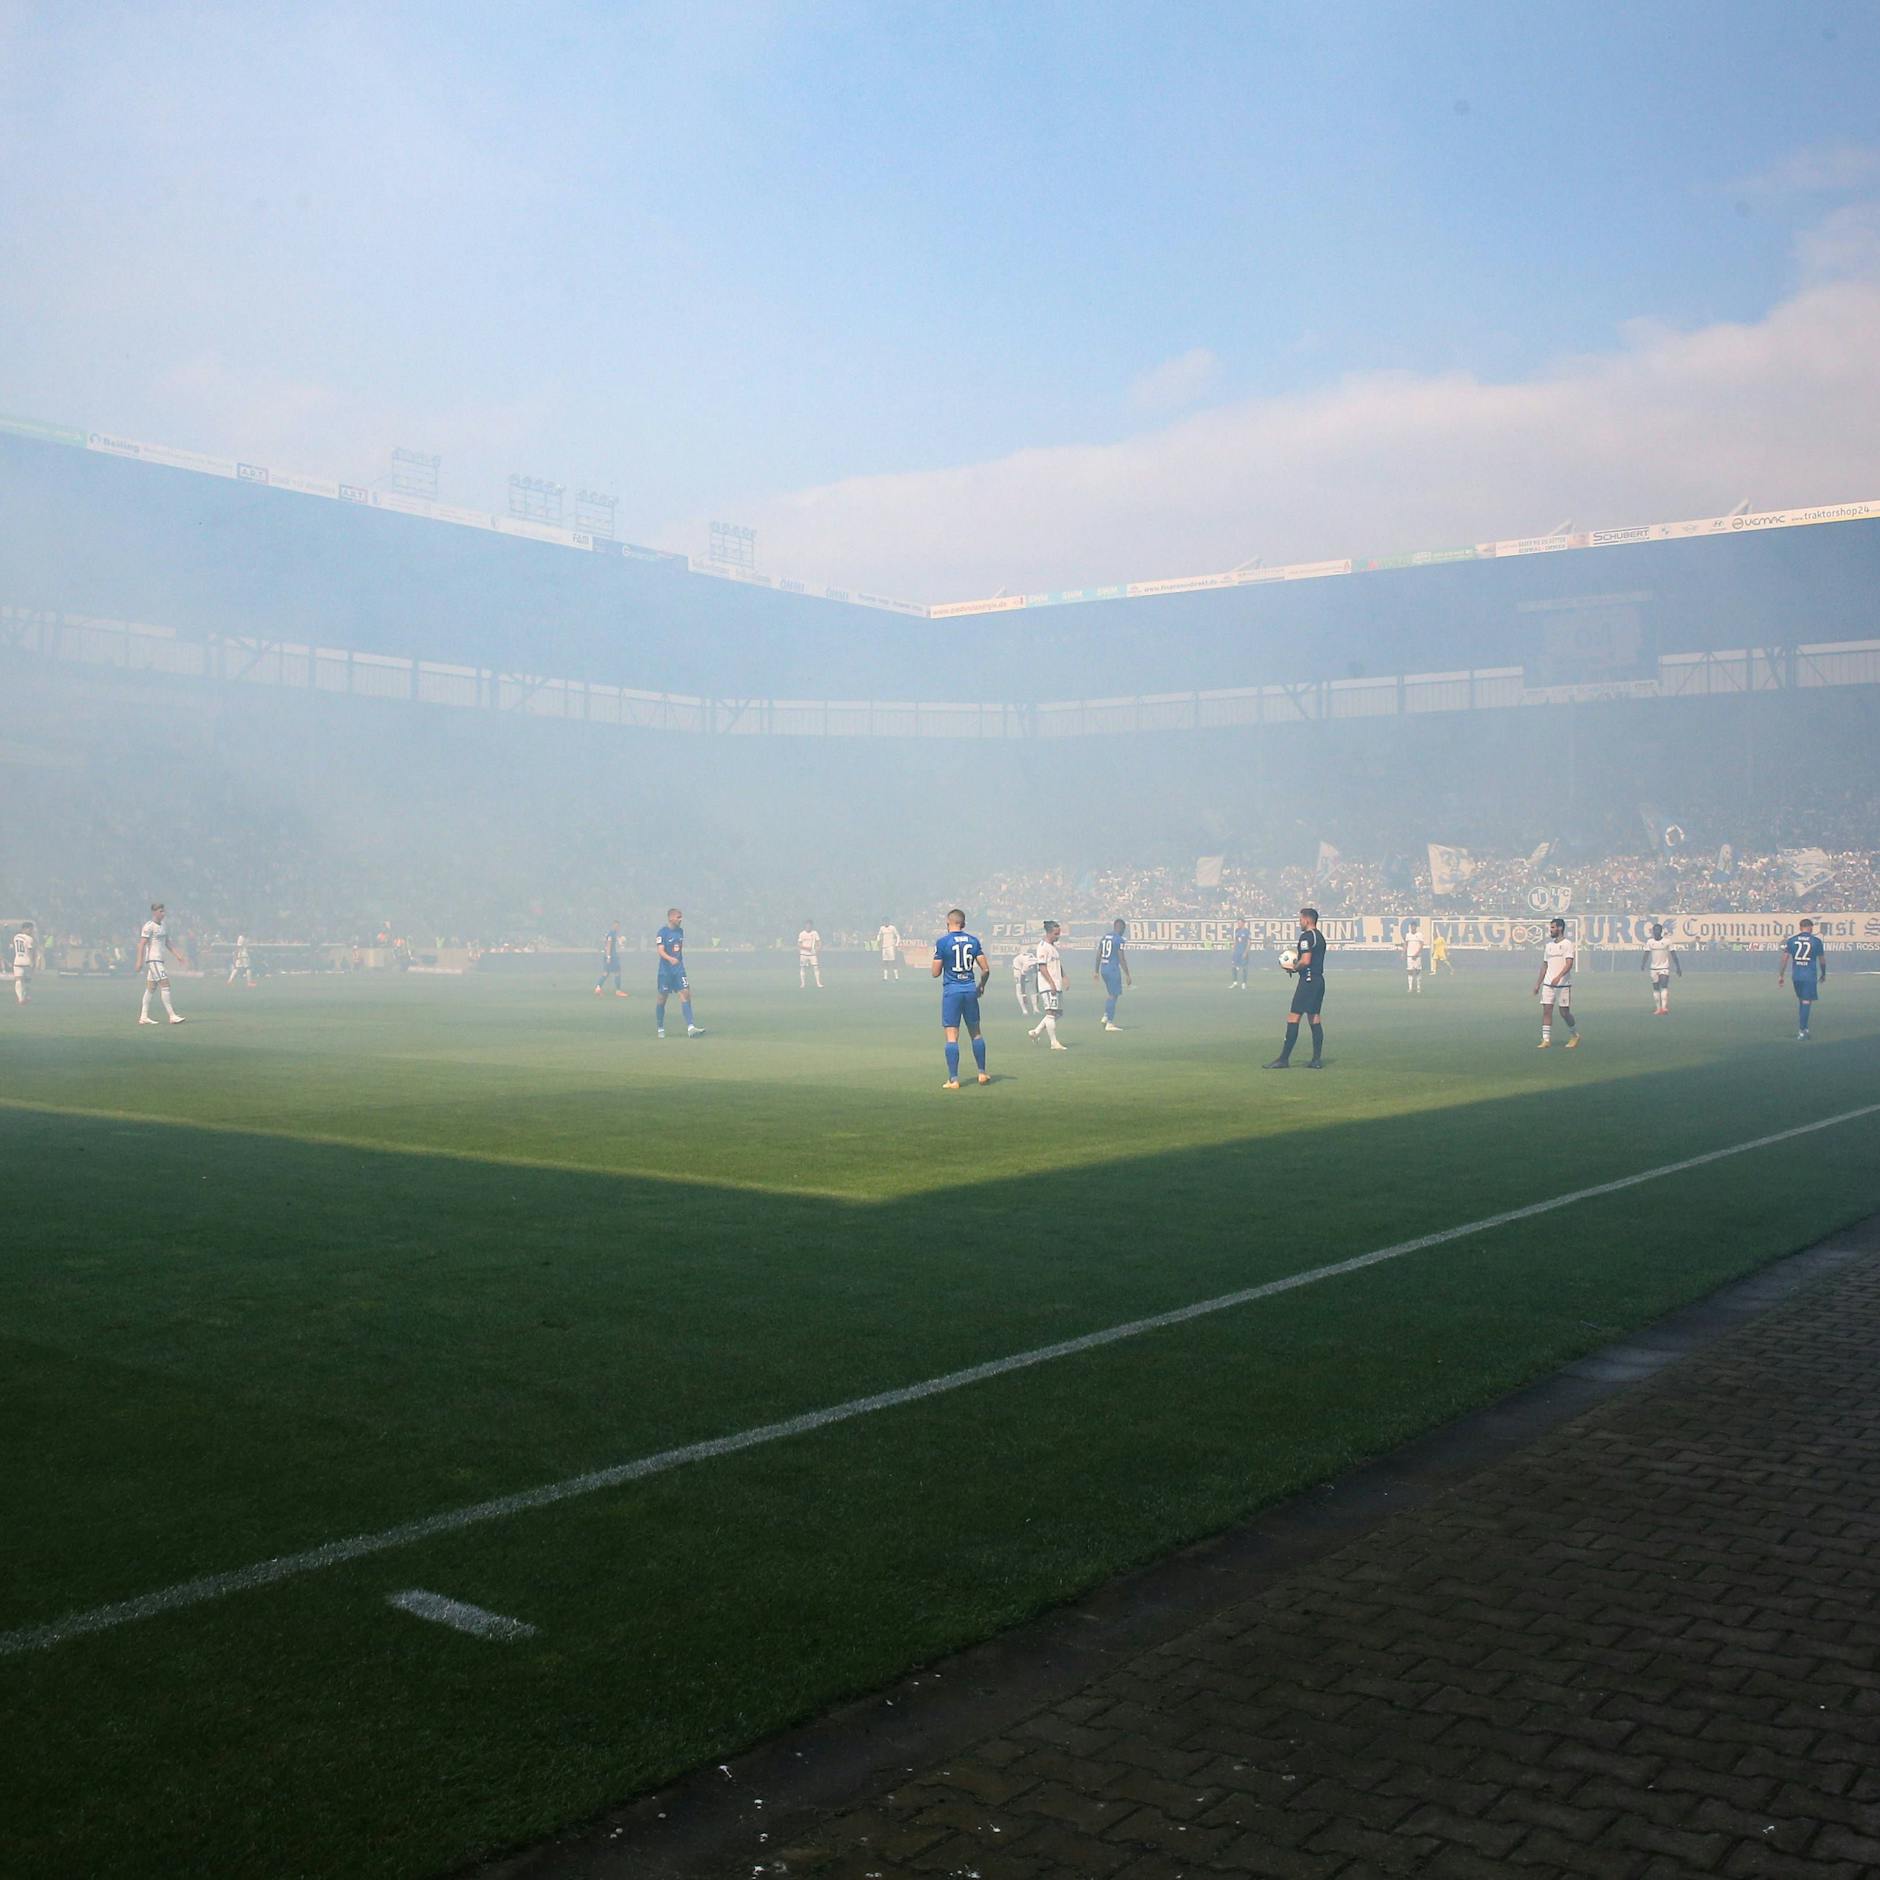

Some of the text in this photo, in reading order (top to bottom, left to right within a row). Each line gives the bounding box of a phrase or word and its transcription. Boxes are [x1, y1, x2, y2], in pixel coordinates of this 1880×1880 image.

[1129, 921, 1185, 941] BLUE
[952, 943, 974, 972] 16
[1102, 939, 1113, 958] 19
[1794, 941, 1812, 961] 22
